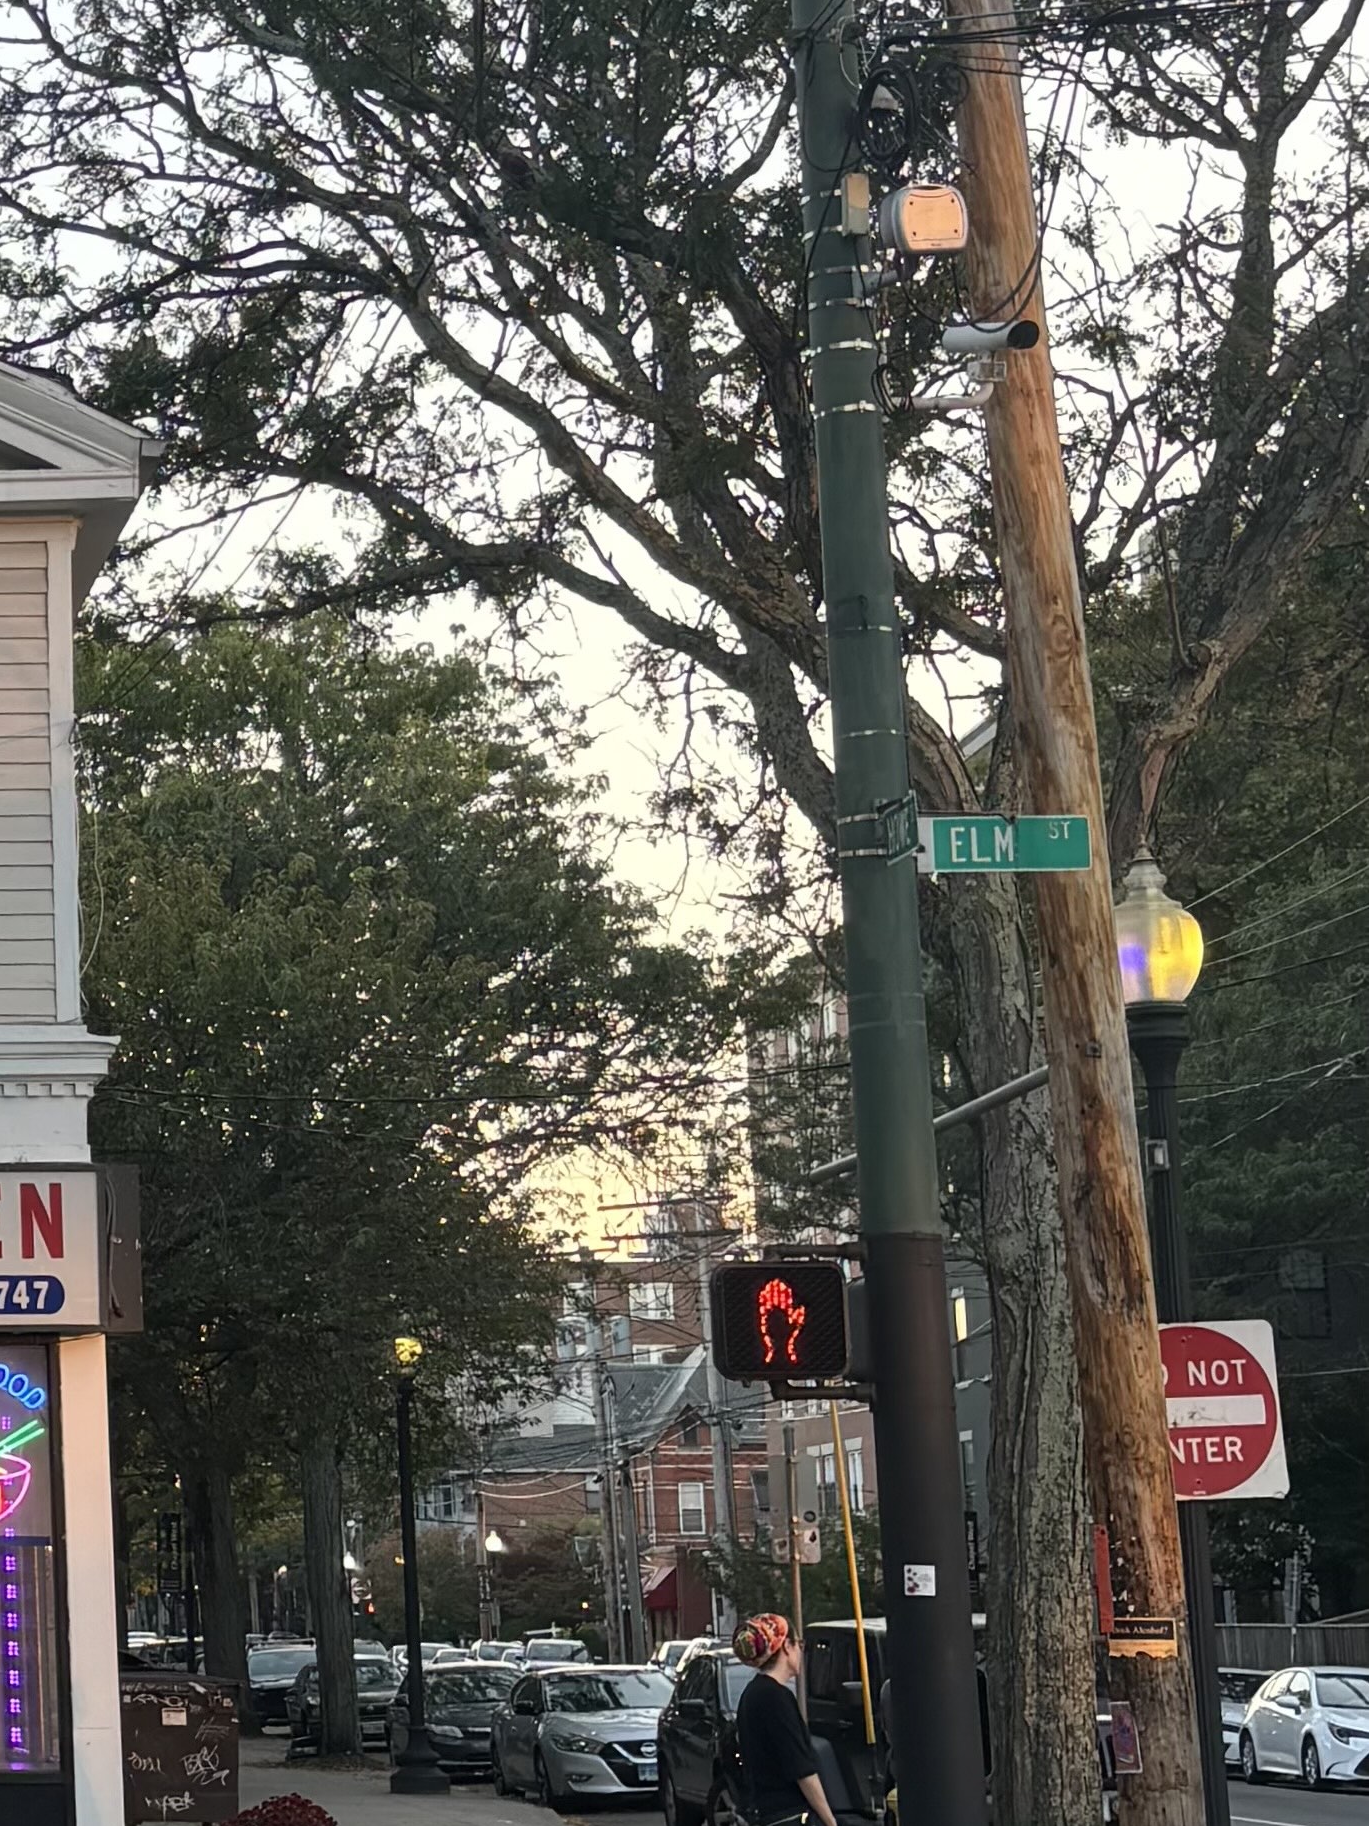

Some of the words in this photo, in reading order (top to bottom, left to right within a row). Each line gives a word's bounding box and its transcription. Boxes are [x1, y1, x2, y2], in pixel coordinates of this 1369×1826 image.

[950, 825, 1014, 863] ELM
[1048, 820, 1070, 839] ST
[1187, 1358, 1247, 1387] NOT
[1169, 1435, 1245, 1465] NTER
